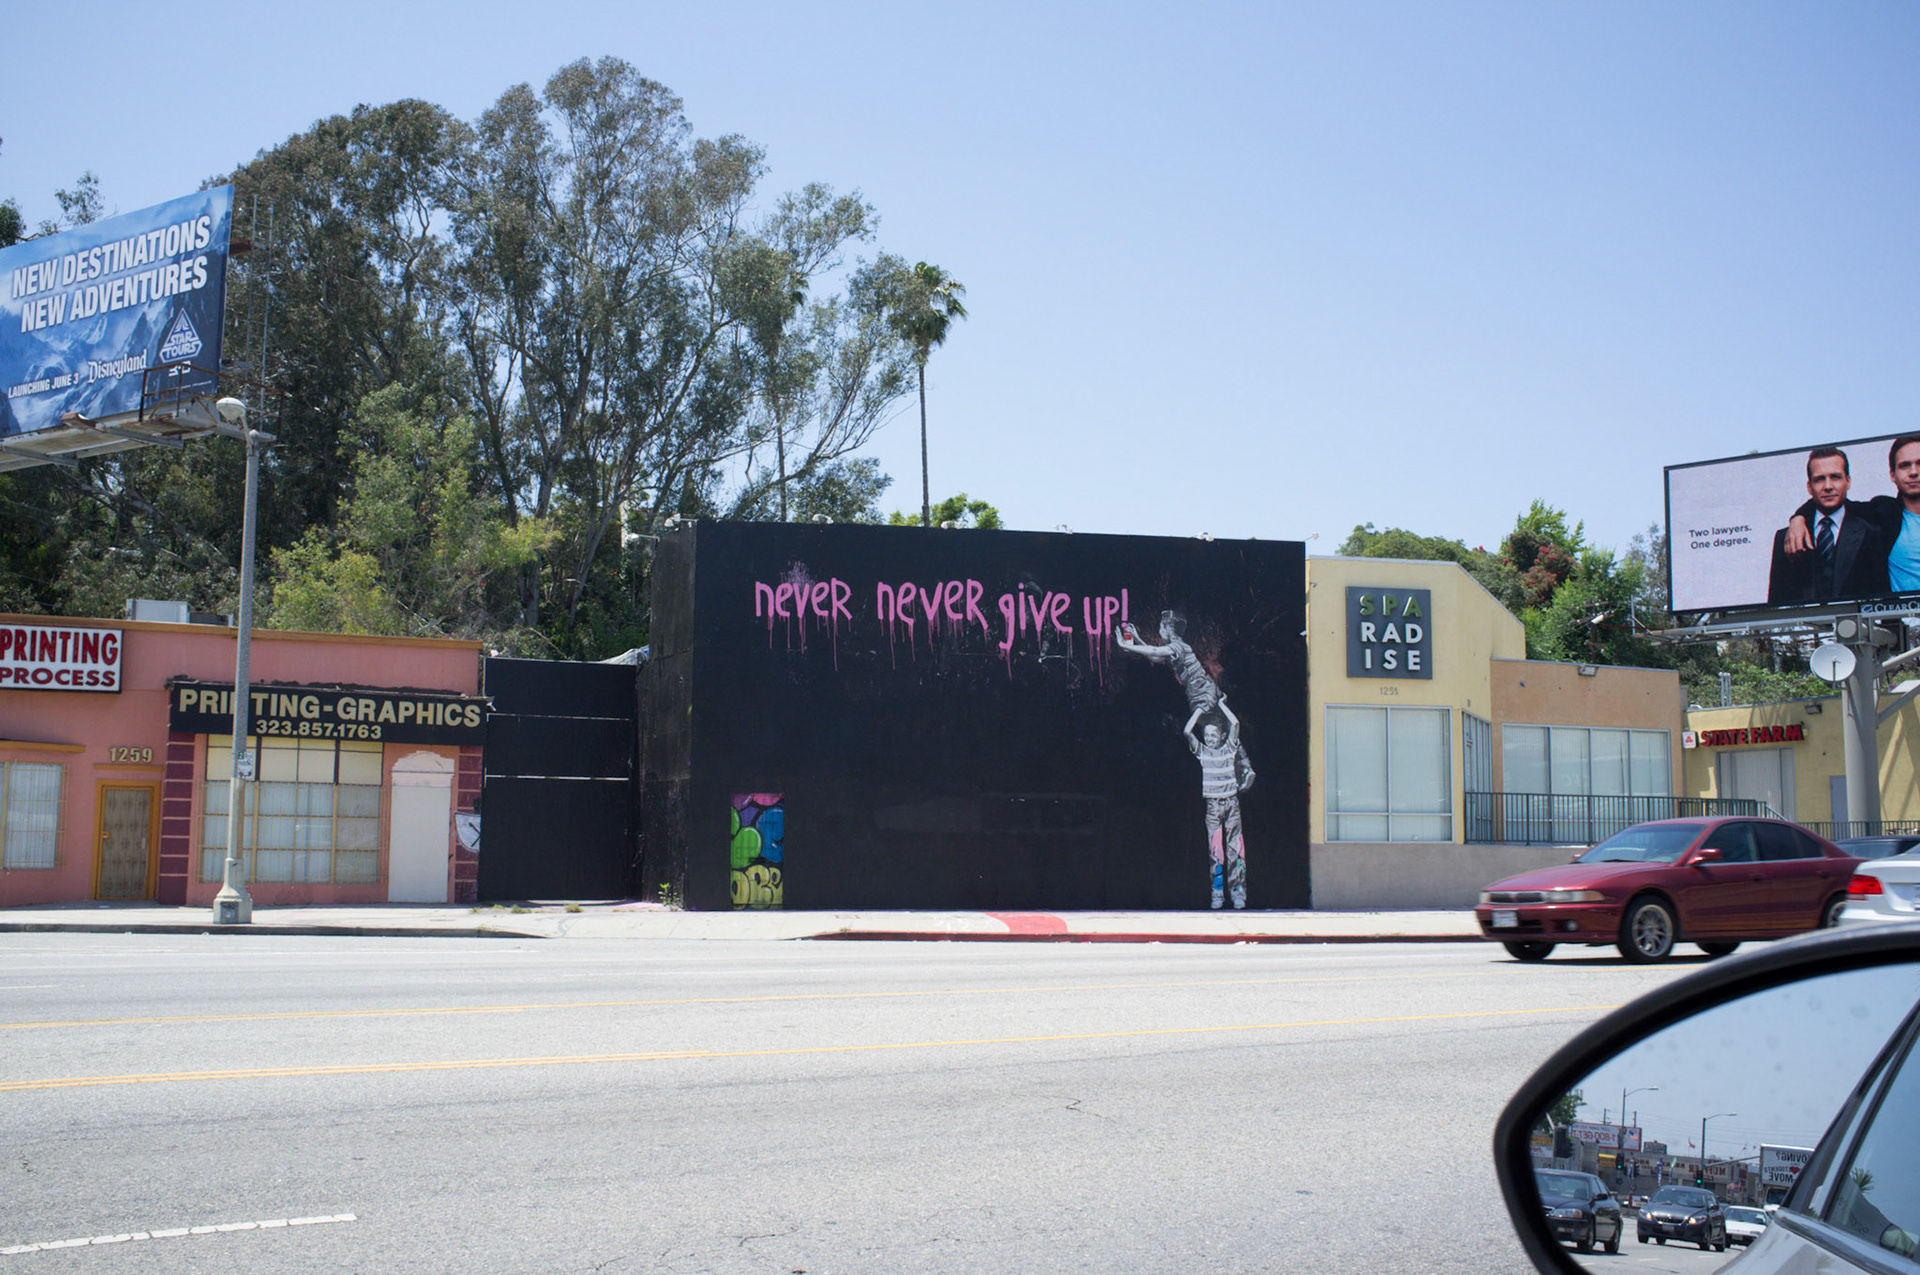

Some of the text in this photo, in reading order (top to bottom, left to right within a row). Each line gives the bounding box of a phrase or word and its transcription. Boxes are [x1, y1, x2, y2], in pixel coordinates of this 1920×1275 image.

[12, 215, 211, 299] NEW DESTINATIONS
[21, 255, 208, 334] NEW ADVENTURES
[163, 341, 201, 359] TOURS
[168, 332, 198, 347] STAR
[87, 349, 147, 384] Disneyland
[8, 372, 79, 399] LAUNCHING JUNE 3
[1689, 525, 1752, 538] Two lawyers.
[1690, 536, 1751, 550] One degree.
[998, 582, 1073, 650] give
[1359, 594, 1422, 617] SPA
[1360, 621, 1423, 644] RAD
[0, 628, 118, 666] PRINTING
[1364, 648, 1421, 671] ISE
[0, 667, 116, 687] PROCESS
[256, 719, 382, 740] 323.857.1763
[1700, 723, 1804, 748] STATE FARM
[109, 747, 153, 763] 1259
